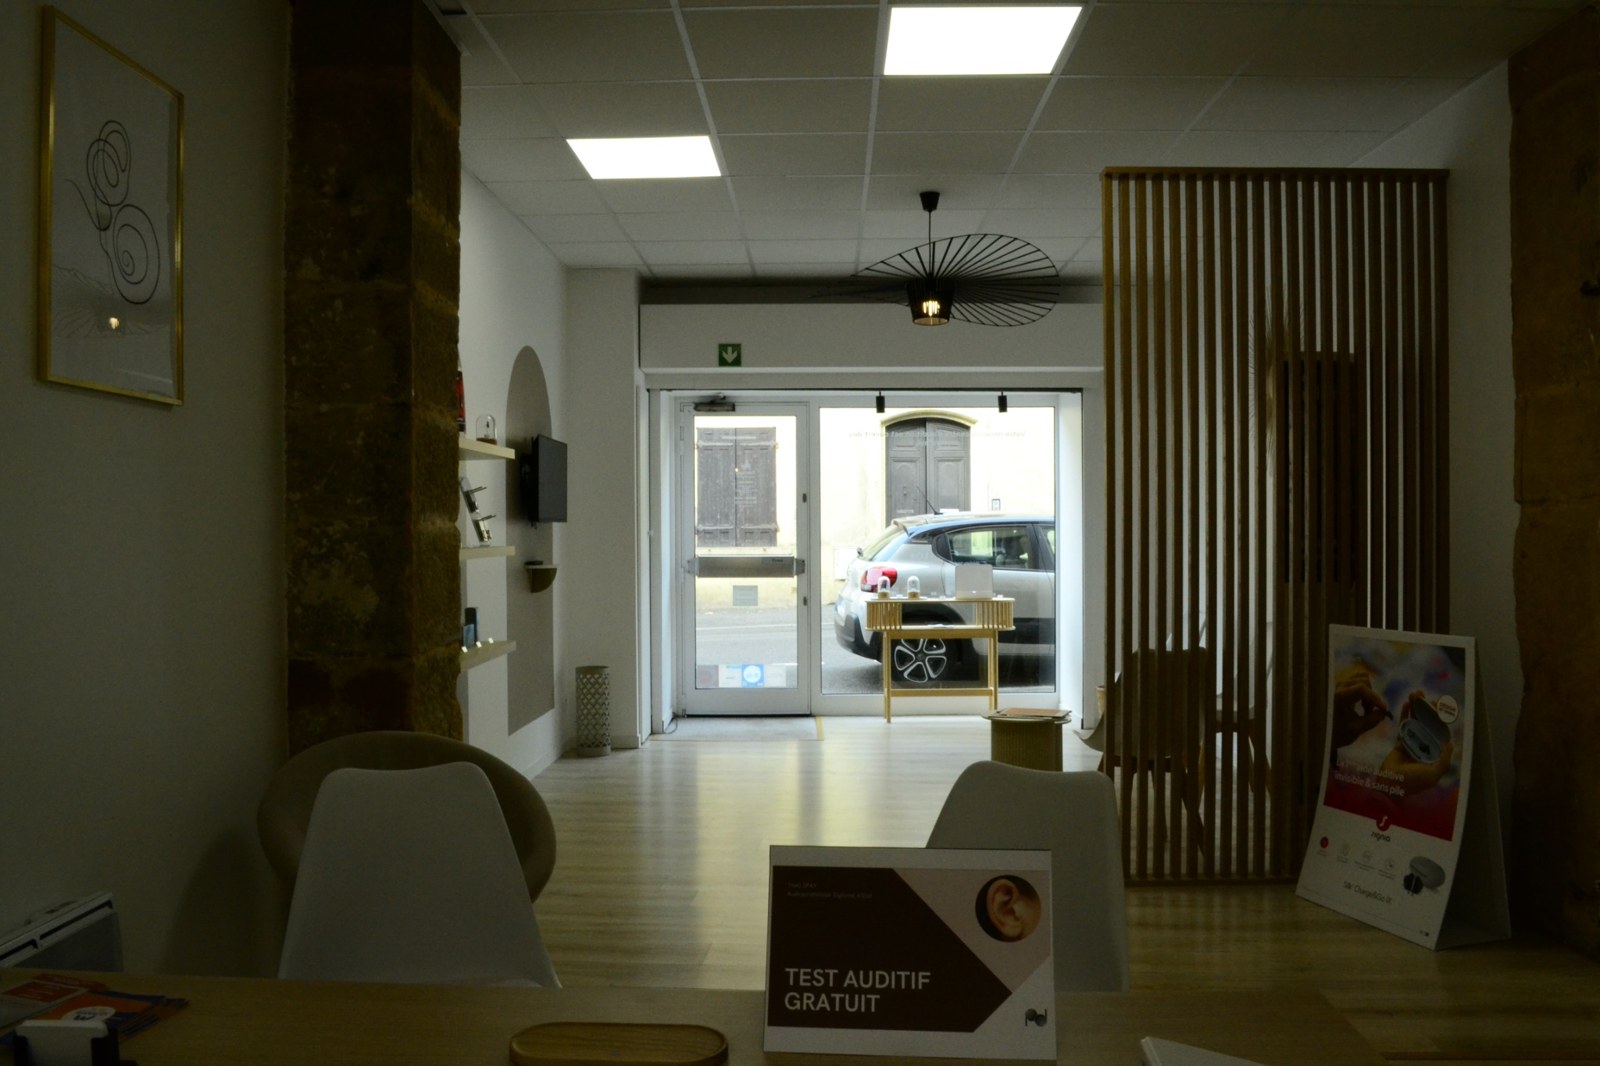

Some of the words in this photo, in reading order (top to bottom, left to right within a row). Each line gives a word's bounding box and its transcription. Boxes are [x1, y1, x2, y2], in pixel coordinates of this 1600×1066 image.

[1372, 782, 1389, 792] sans
[1389, 784, 1405, 797] pile
[784, 967, 839, 988] TEST
[843, 969, 932, 989] AUDITIF
[783, 991, 881, 1013] GRATUIT
